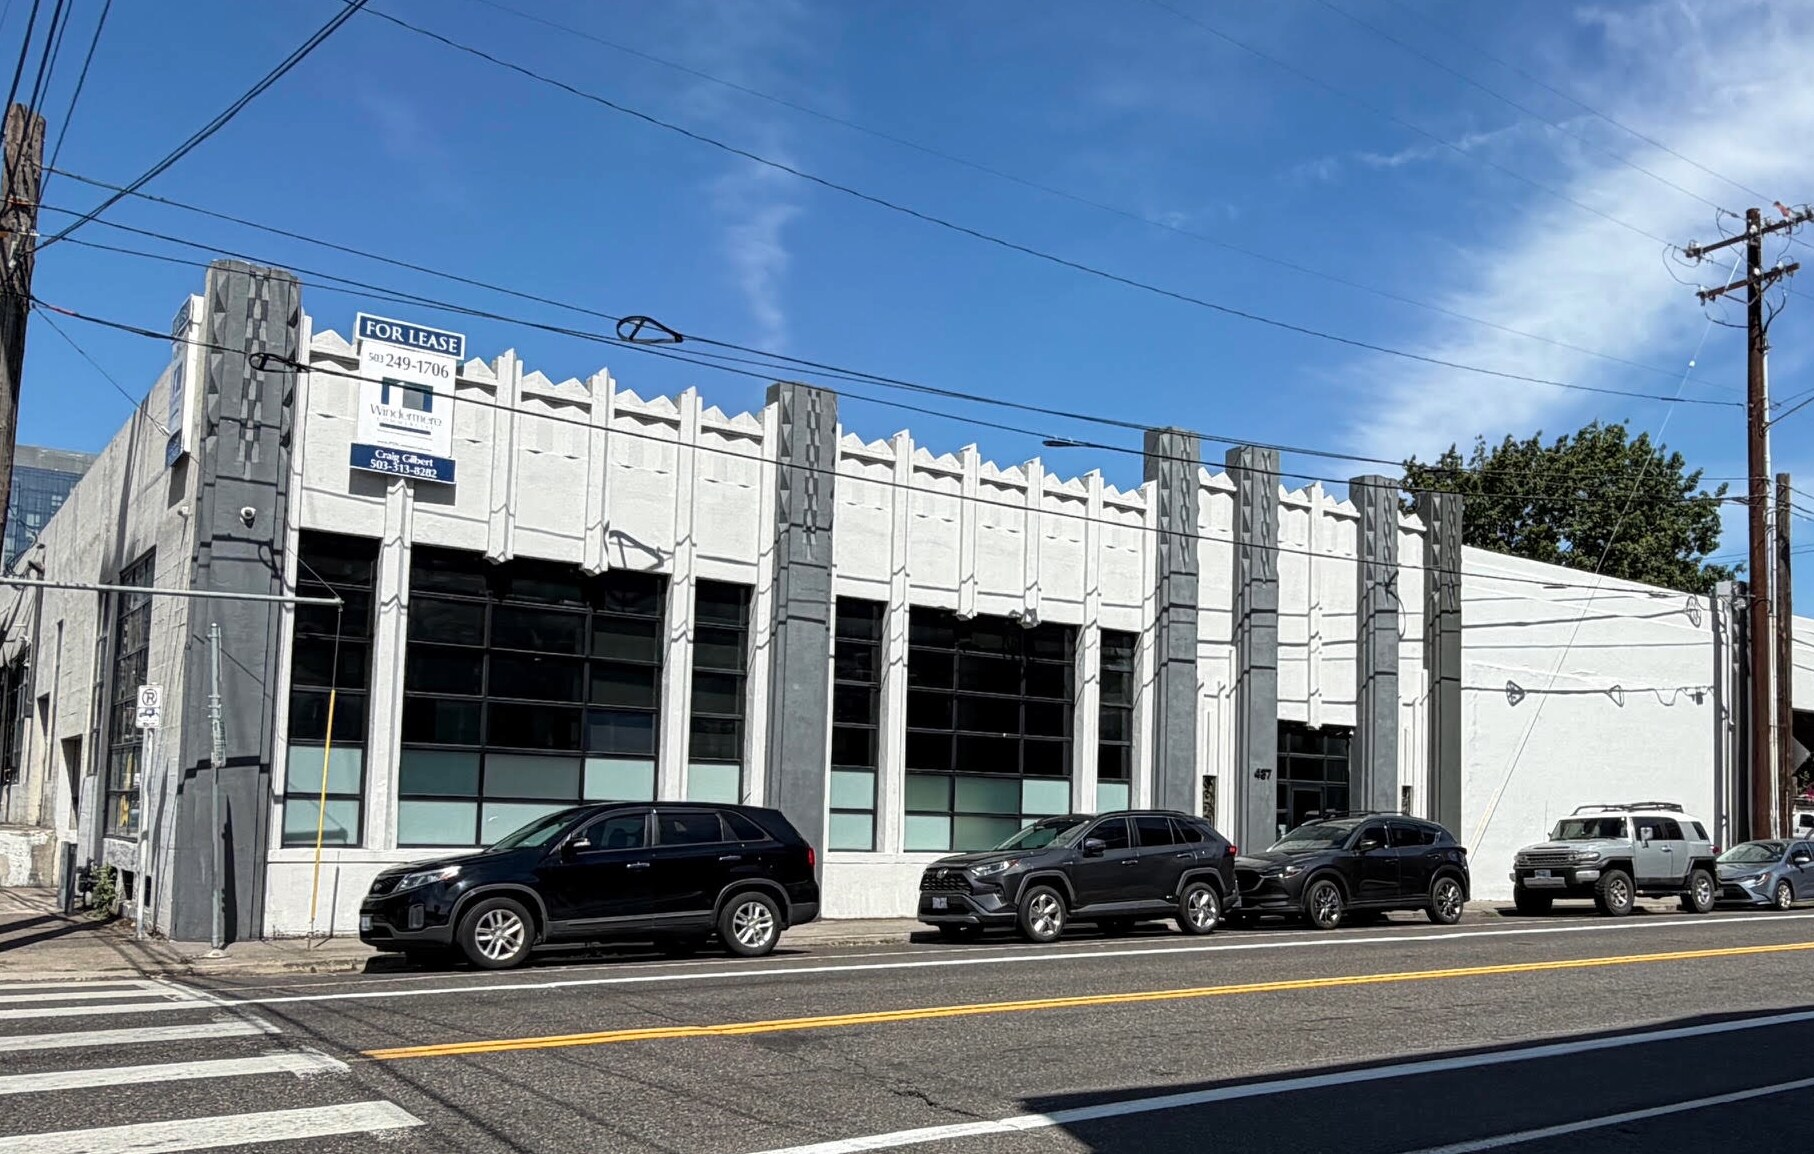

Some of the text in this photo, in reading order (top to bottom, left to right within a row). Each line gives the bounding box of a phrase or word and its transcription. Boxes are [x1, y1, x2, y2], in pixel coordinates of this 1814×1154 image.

[366, 320, 458, 353] FOR LEASE
[368, 352, 449, 378] 503 249-1706
[370, 459, 437, 478] 503-313-8282
[375, 449, 433, 467] Craig Gilbert
